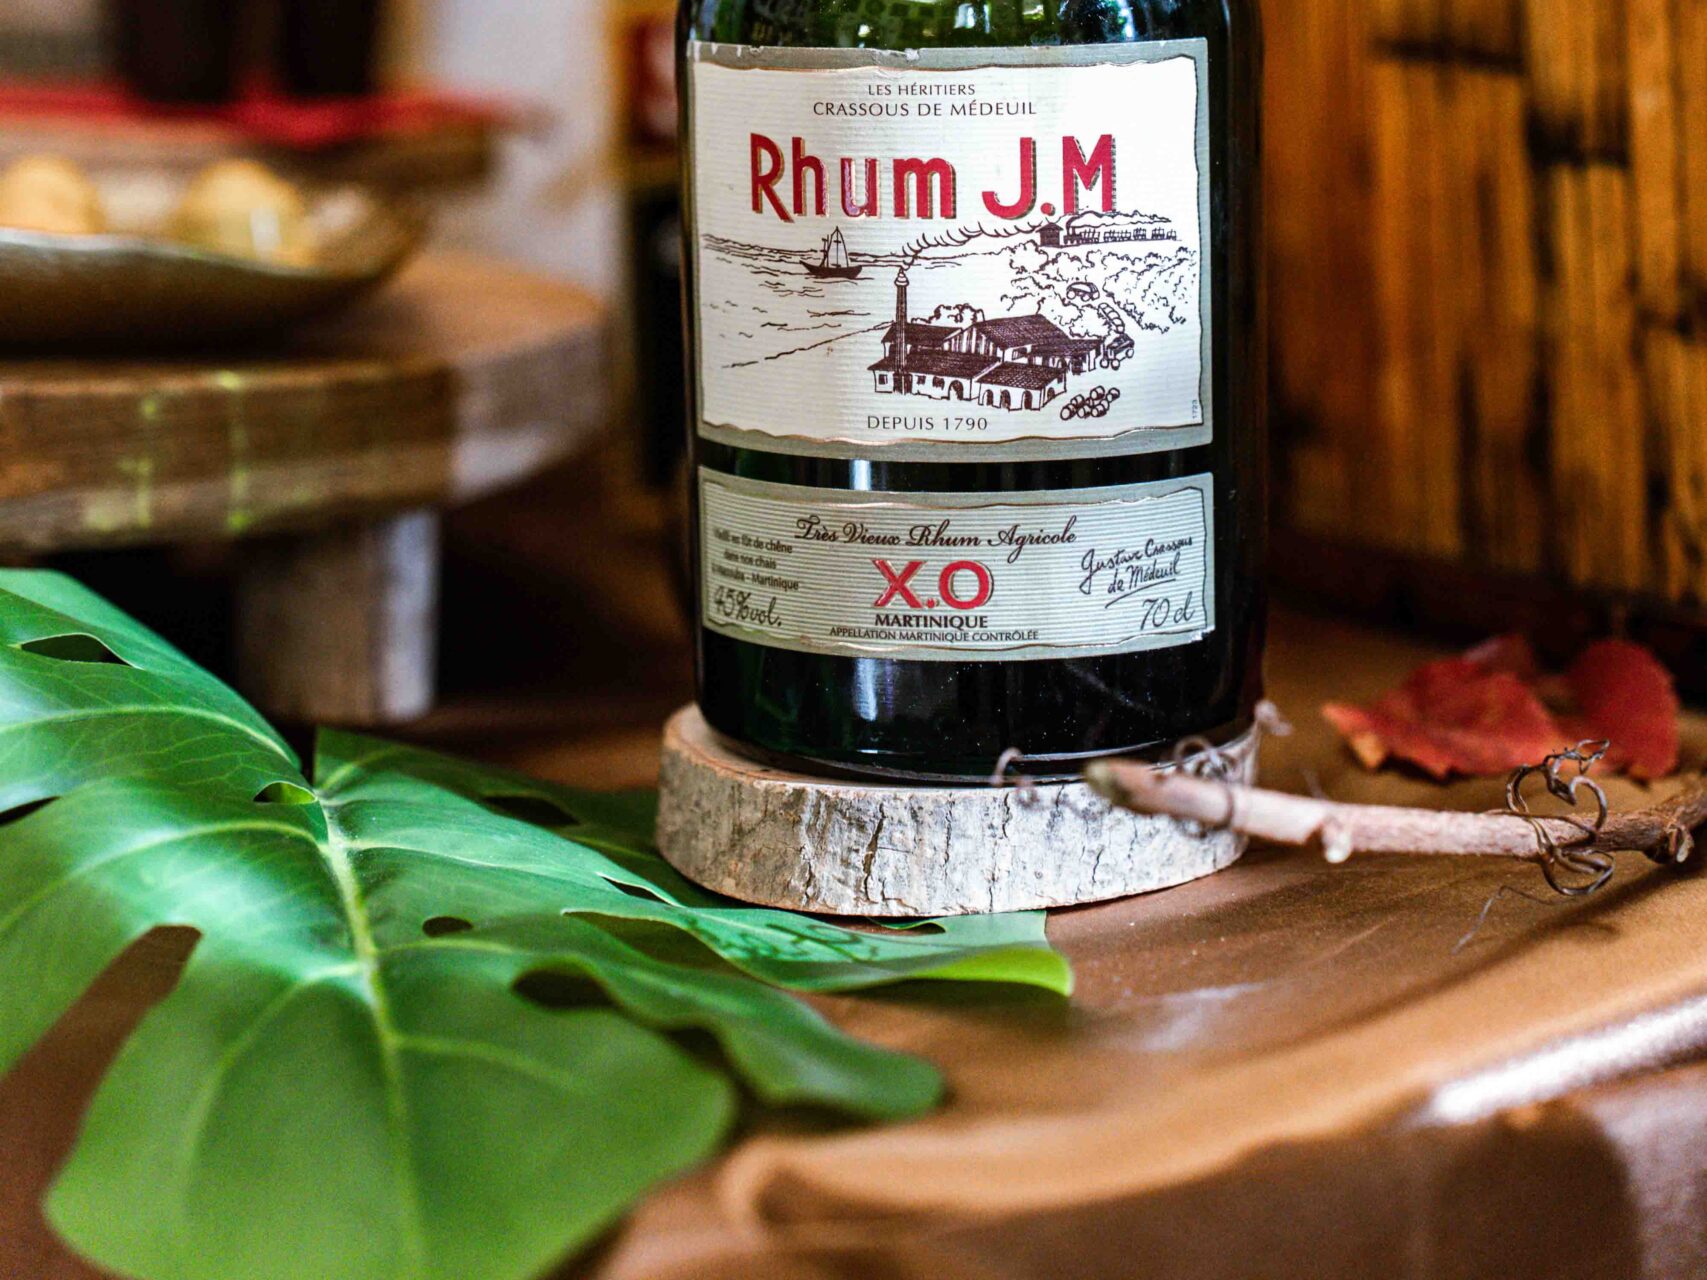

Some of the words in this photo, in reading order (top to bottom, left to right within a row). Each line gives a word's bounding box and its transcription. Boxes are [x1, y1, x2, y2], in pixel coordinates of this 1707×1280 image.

[868, 84, 892, 96] LES
[898, 82, 976, 96] HÉRITIERS
[813, 102, 909, 117] CRASSOUS
[917, 102, 943, 117] DE
[950, 99, 1037, 117] MÉDEUIL
[750, 132, 957, 223] Rhum
[982, 134, 1117, 220] J.M
[867, 416, 934, 430] DEPUIS
[943, 417, 988, 431] 1790
[753, 537, 765, 550] de
[765, 540, 793, 554] chêne
[794, 514, 840, 542] Très
[842, 523, 901, 547] Vieux
[905, 519, 981, 548] Rhum
[987, 515, 1078, 565] Agricole
[755, 556, 777, 570] chais
[1079, 548, 1143, 595] Gustave
[1108, 568, 1125, 594] de
[1125, 551, 1181, 590] Médeuil
[752, 573, 799, 592] Martinique
[871, 558, 995, 610] X.O
[874, 614, 989, 630] MARTINIQUE
[1141, 597, 1171, 631] 70
[829, 626, 899, 640] APPELLATION
[899, 630, 969, 643] MARTINIQUE
[972, 628, 1040, 642] CONTRÔLÉE
